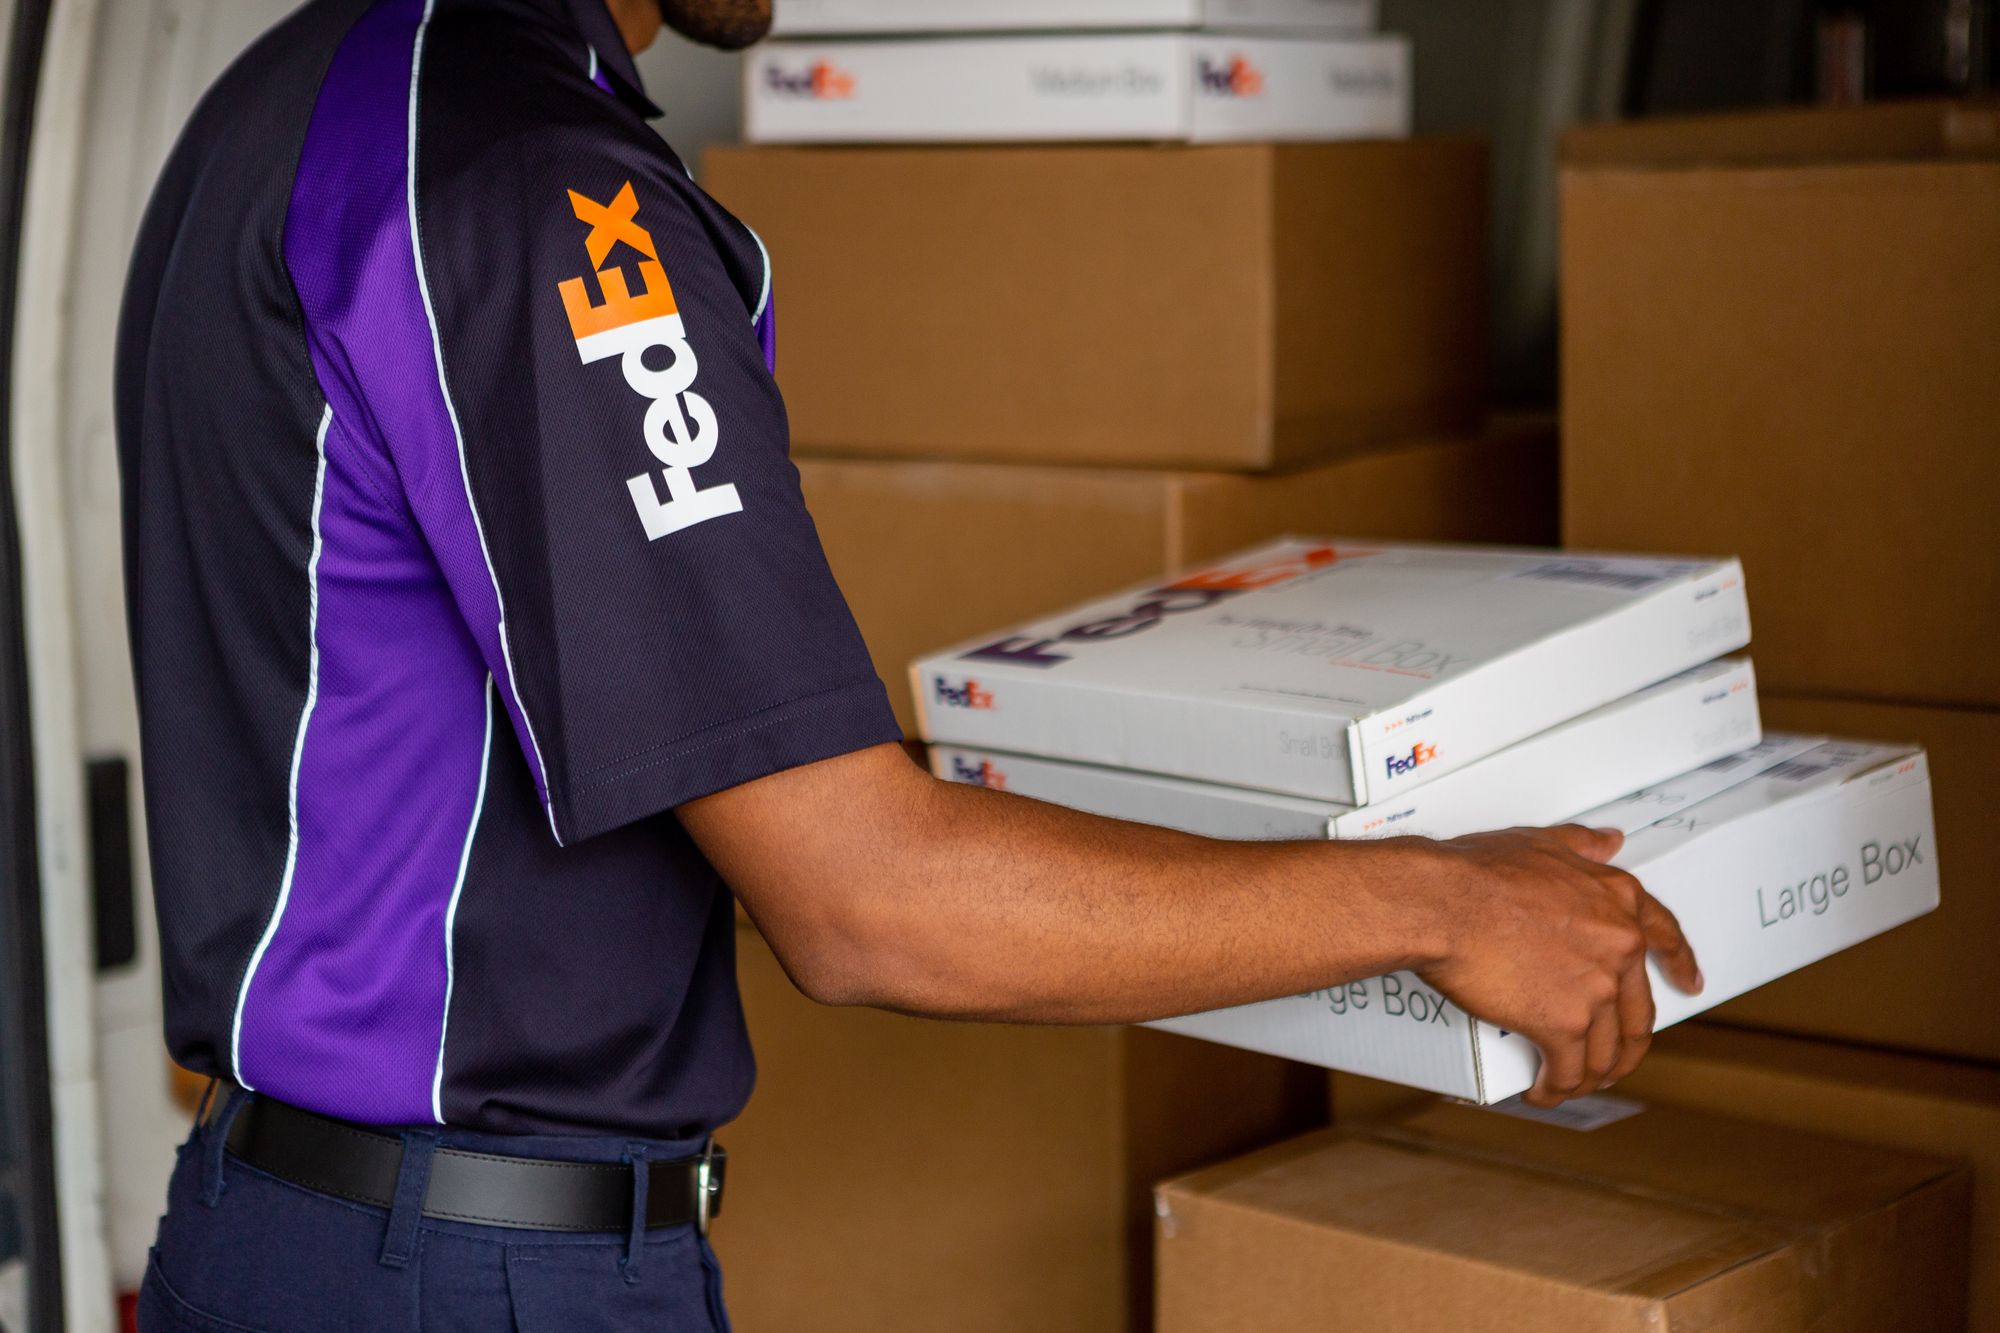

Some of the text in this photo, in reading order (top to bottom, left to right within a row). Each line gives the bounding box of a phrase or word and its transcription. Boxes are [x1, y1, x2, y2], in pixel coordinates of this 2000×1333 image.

[557, 180, 743, 541] FedEx
[935, 676, 996, 710] FedEx
[1279, 730, 1318, 757] Small
[1386, 742, 1438, 779] FedEx
[1756, 832, 1924, 928] Large Box
[1381, 974, 1450, 1027] Box
